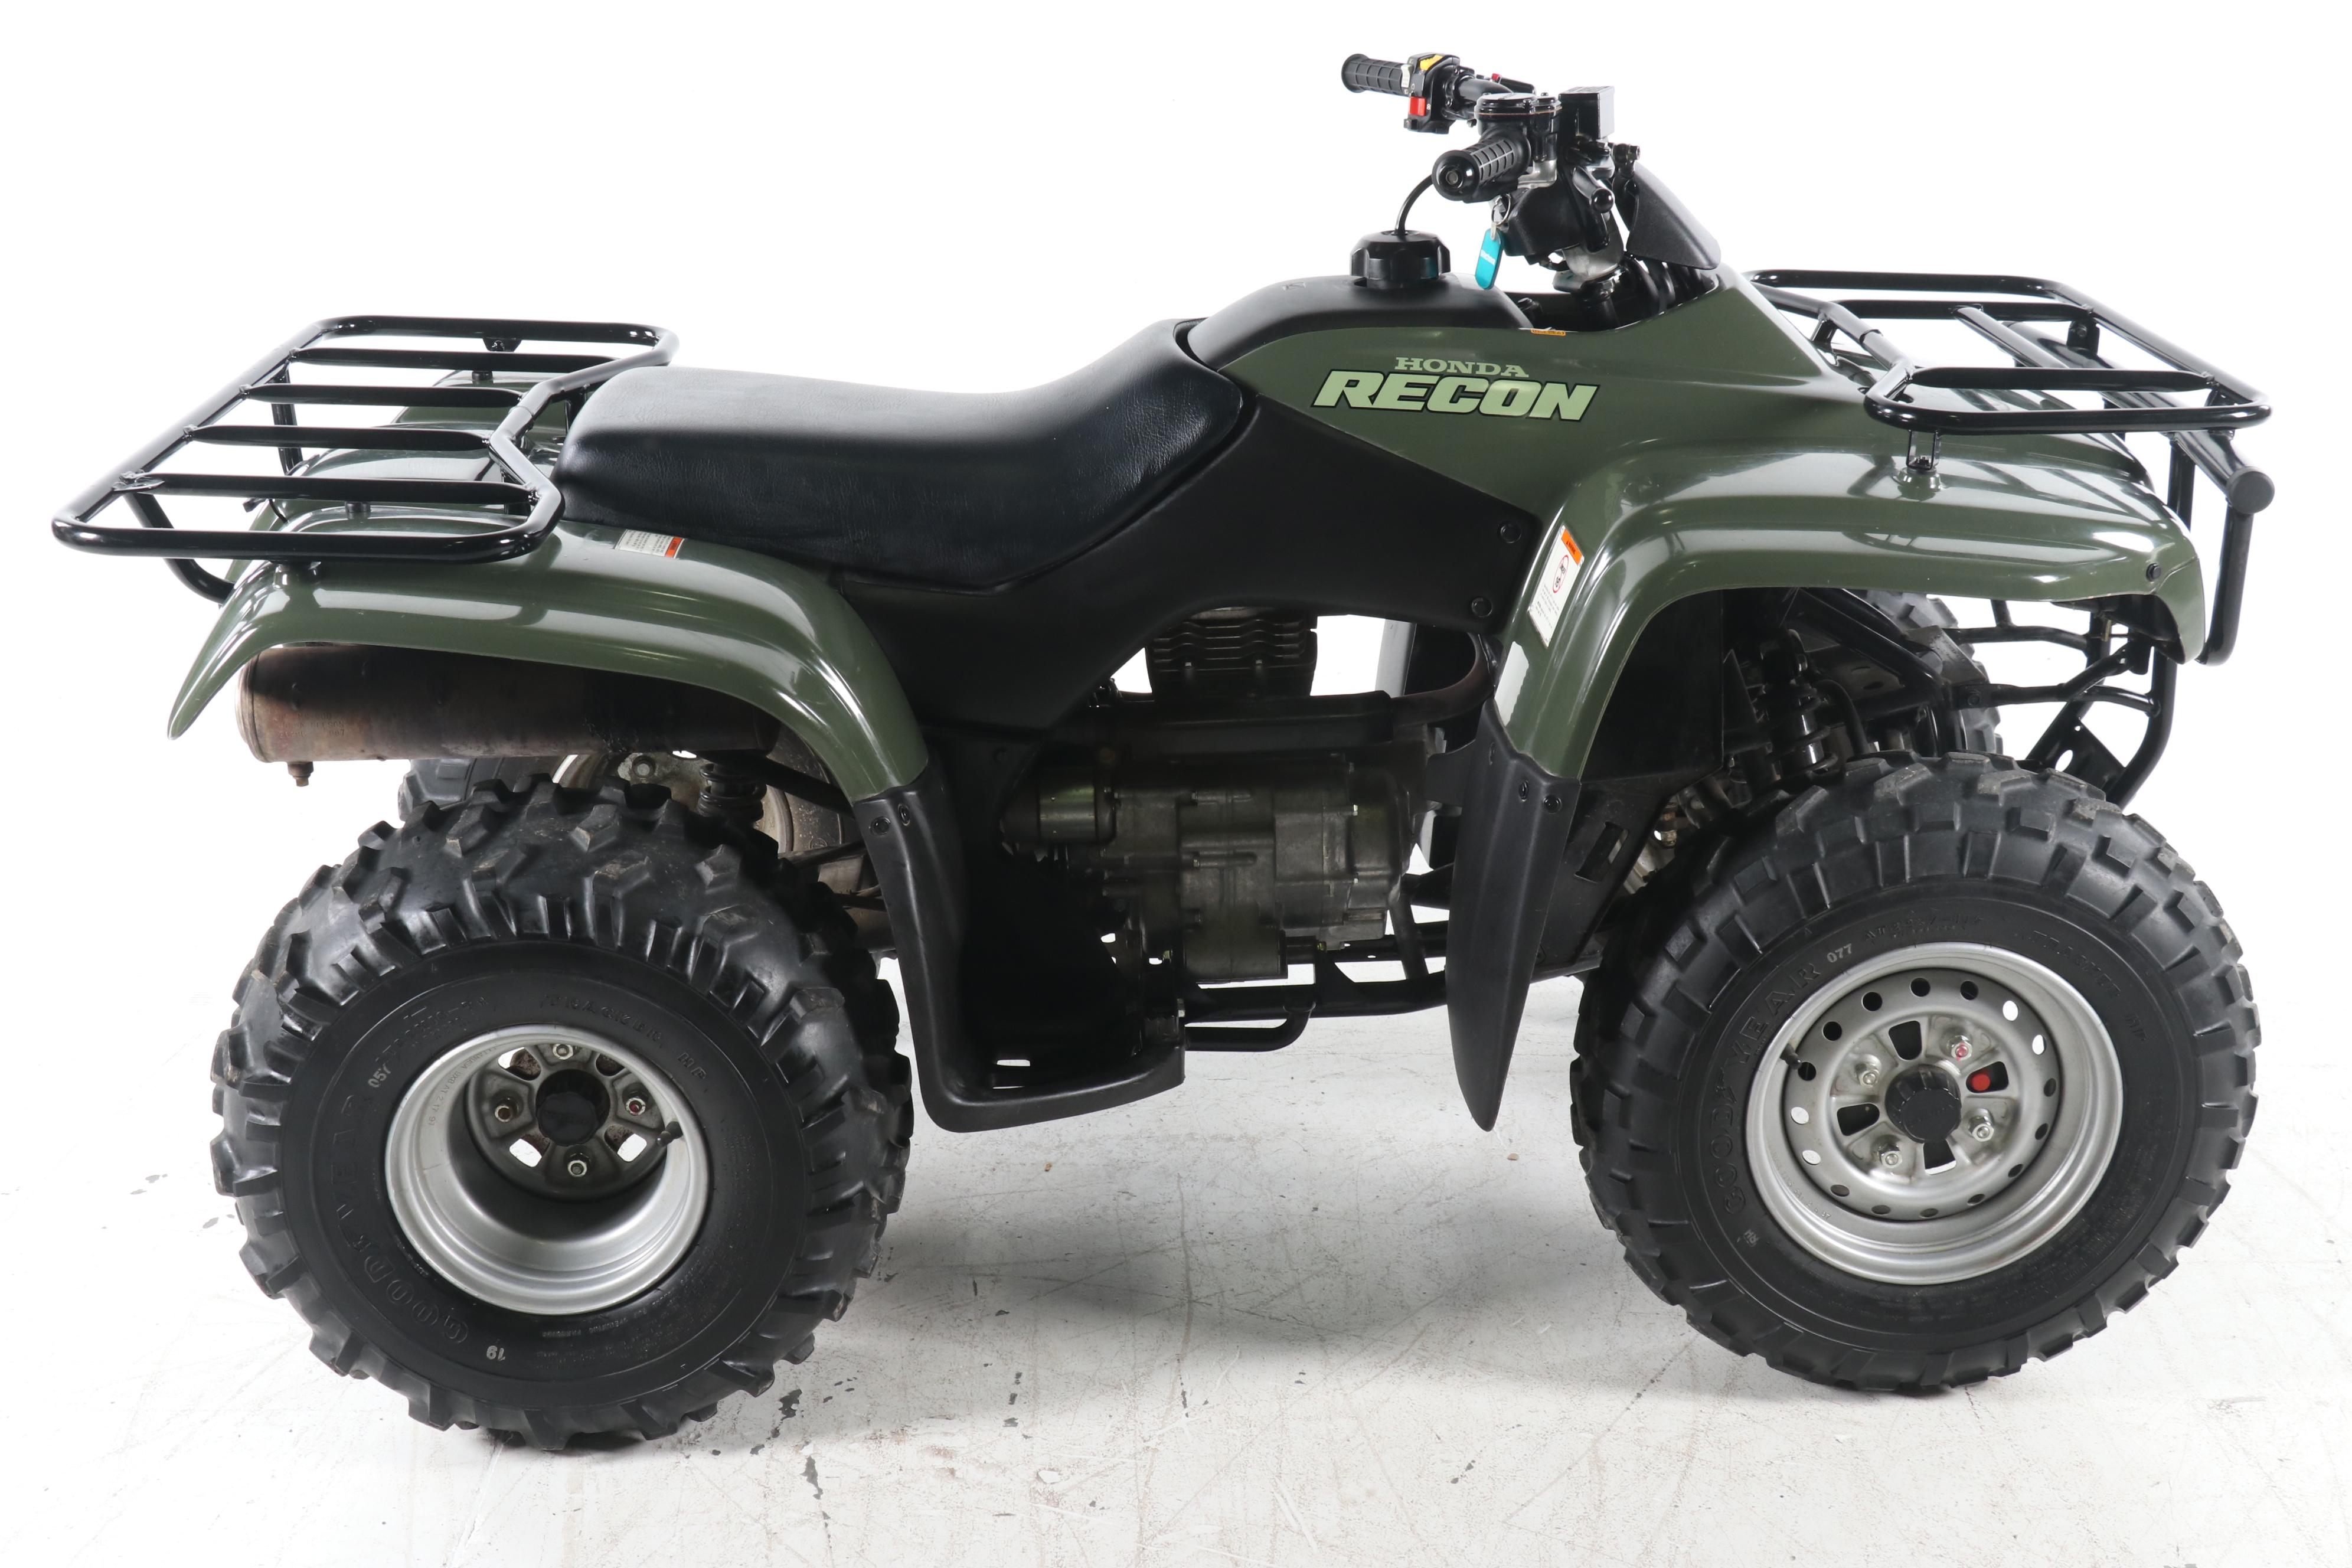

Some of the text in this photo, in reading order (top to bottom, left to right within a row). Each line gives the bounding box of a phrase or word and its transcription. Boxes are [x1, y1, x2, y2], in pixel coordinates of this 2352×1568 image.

[1394, 357, 1530, 378] HONDA
[1311, 368, 1601, 422] RECON
[1827, 943, 1852, 963] 077
[367, 1063, 391, 1088] 057
